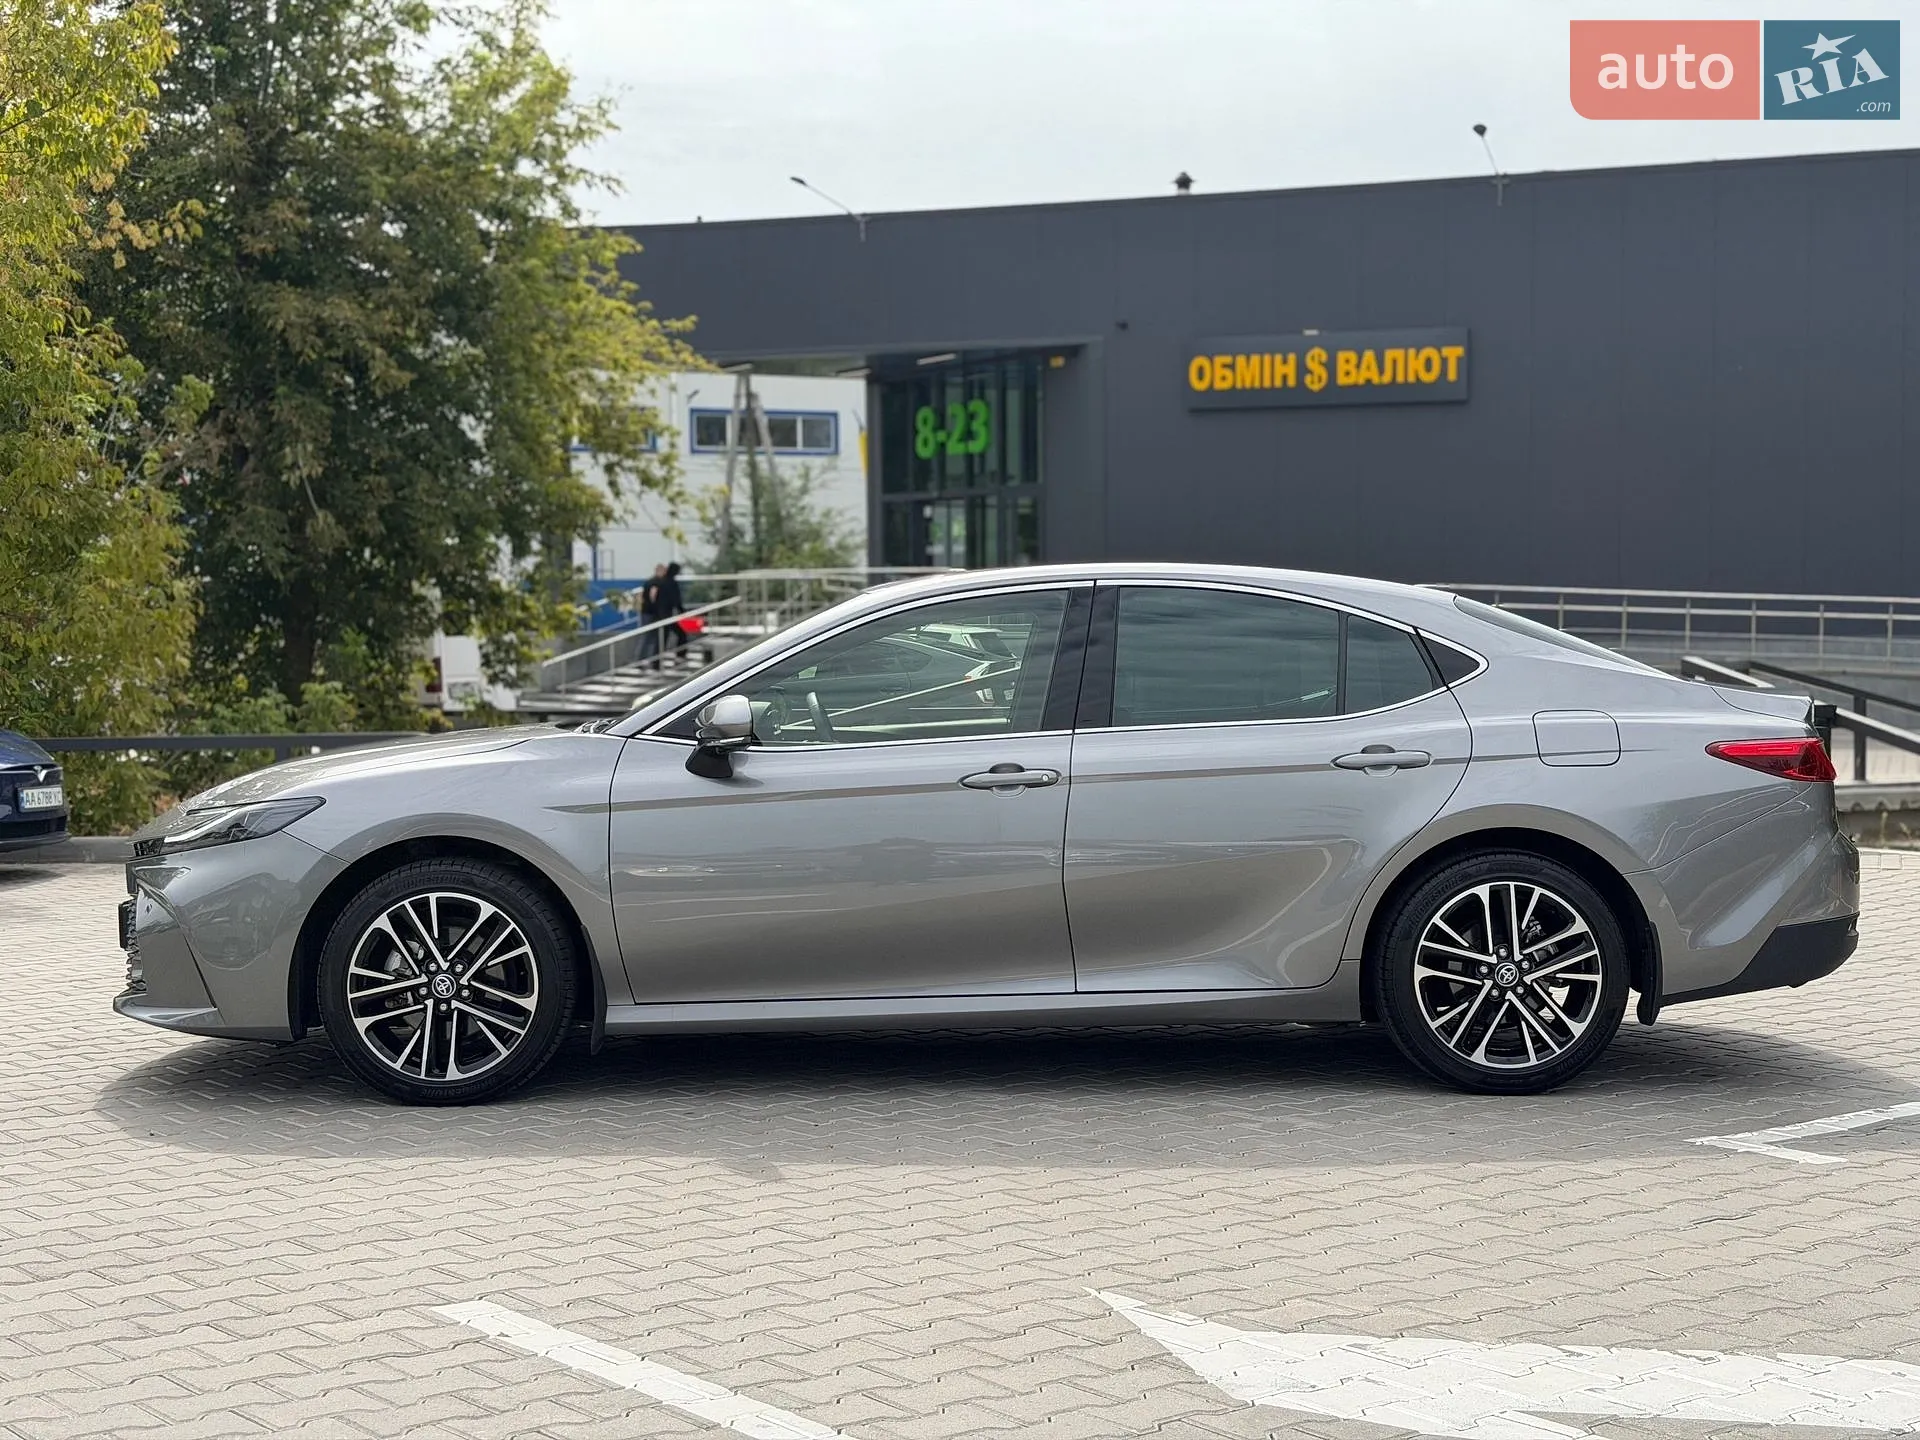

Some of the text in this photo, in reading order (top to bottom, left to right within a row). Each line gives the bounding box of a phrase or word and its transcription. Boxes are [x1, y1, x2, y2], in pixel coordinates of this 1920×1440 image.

[1188, 345, 1465, 392] ОБМІН $ ВАЛЮТ
[915, 399, 989, 459] 8-23
